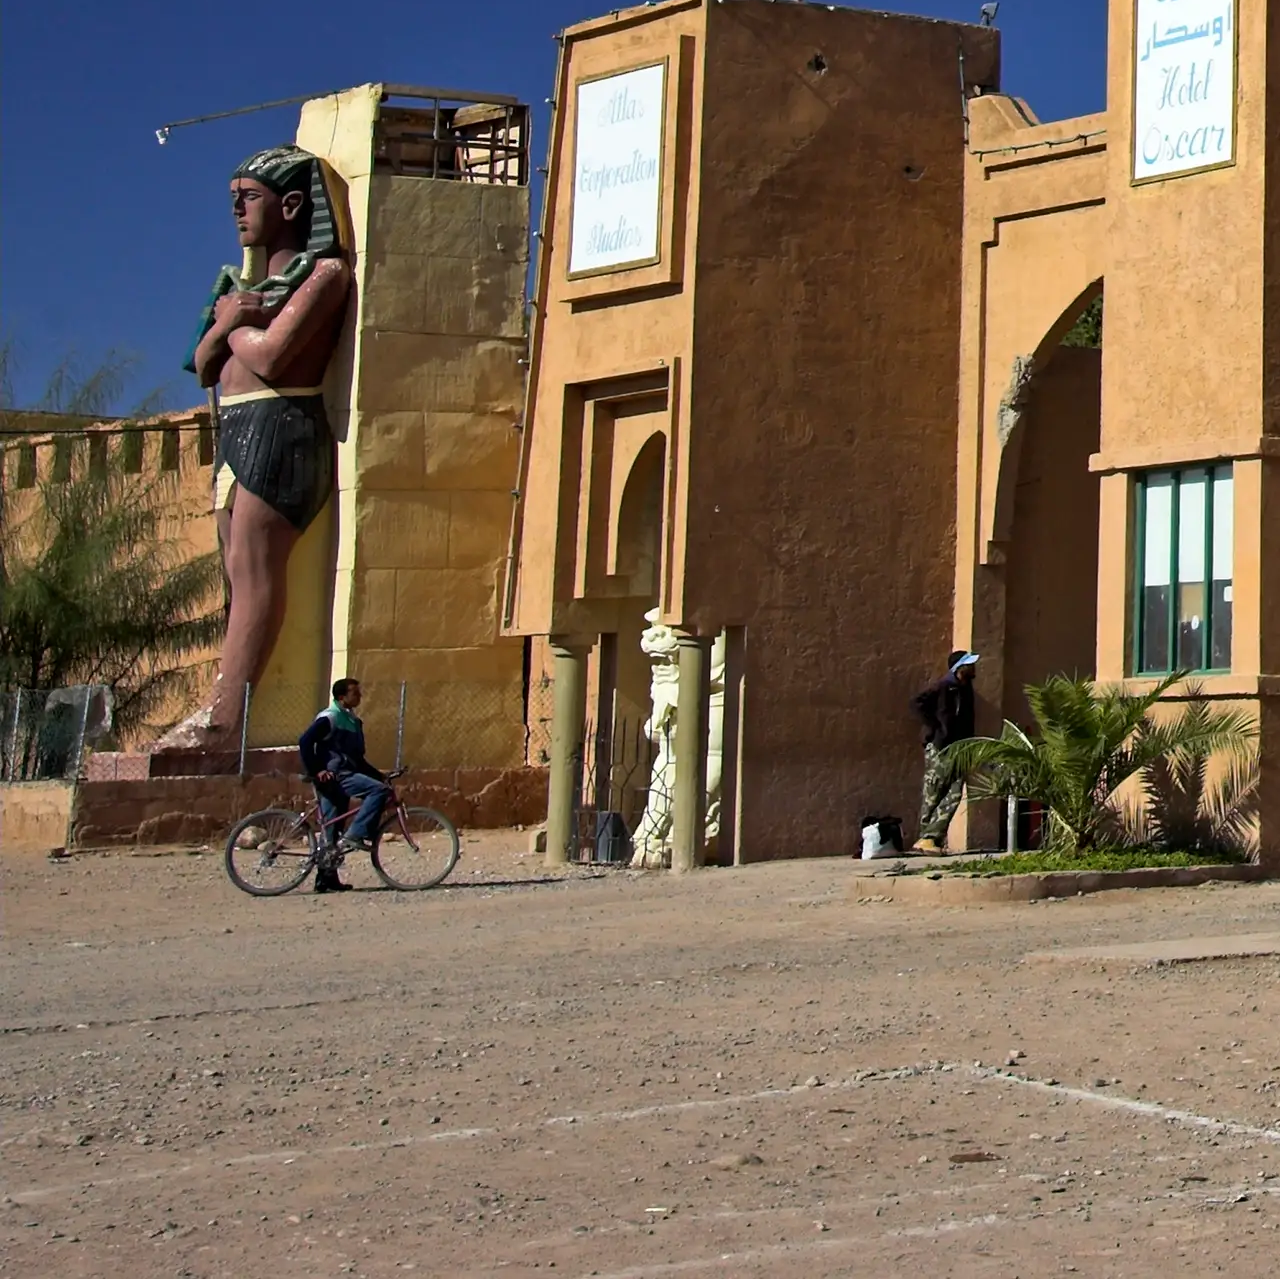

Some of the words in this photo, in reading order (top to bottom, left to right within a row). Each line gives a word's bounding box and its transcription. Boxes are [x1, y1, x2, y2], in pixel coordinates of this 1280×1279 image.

[1140, 2, 1231, 62] اوسكار
[600, 86, 643, 127] Atlas
[1159, 59, 1213, 110] Hotel
[1143, 122, 1225, 164] Oscar
[581, 148, 656, 199] Corporation
[586, 214, 642, 256] Studios
